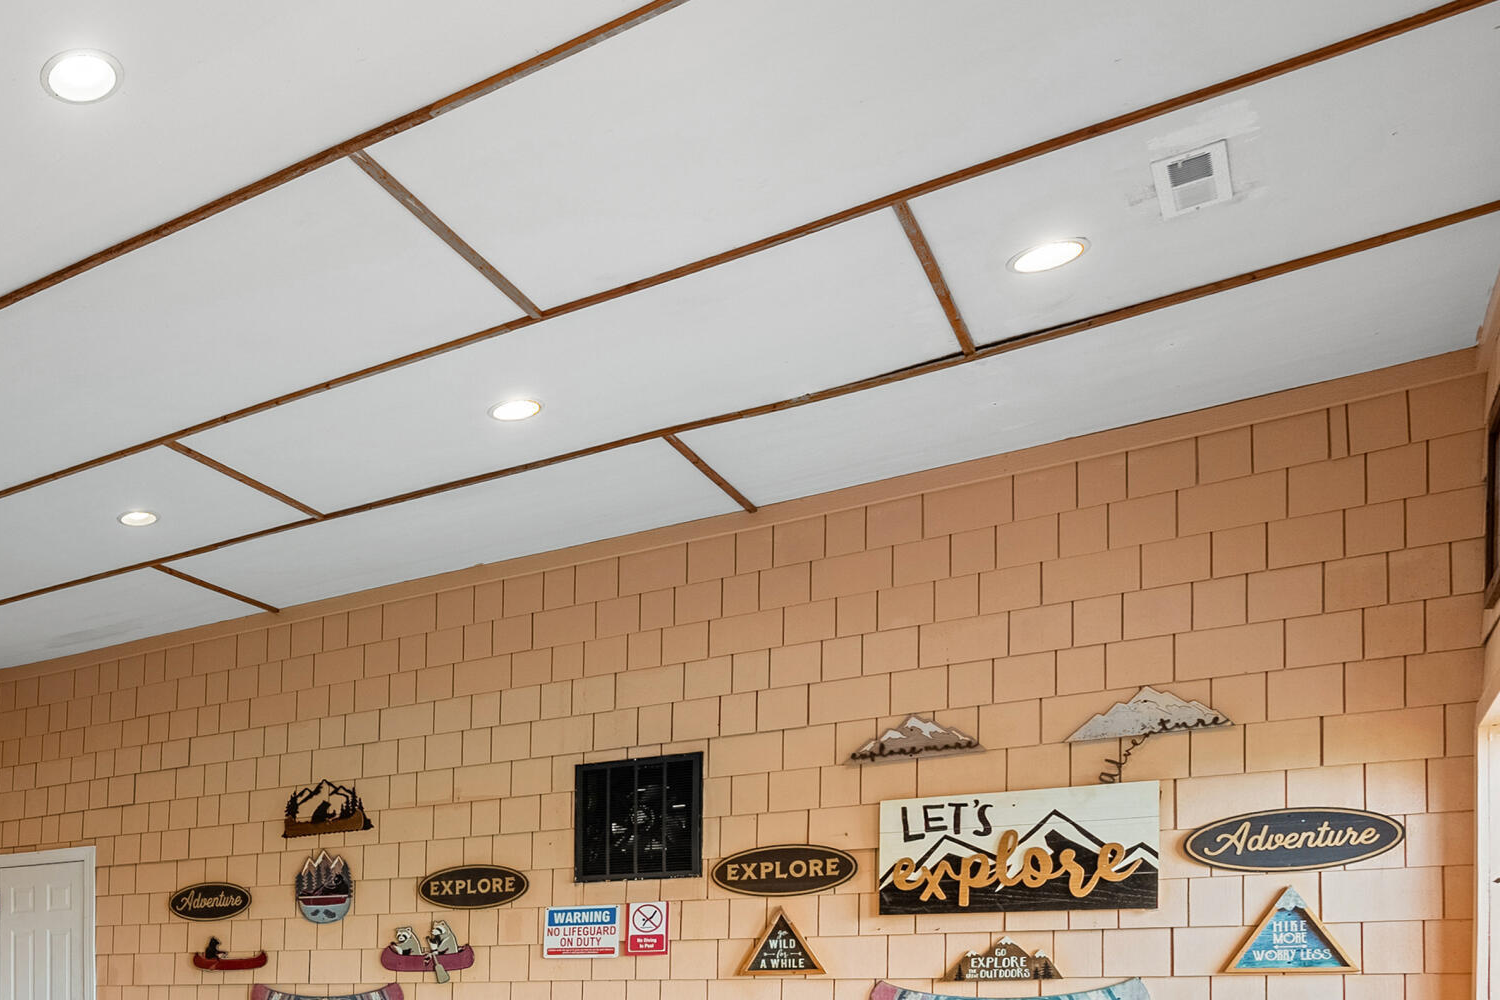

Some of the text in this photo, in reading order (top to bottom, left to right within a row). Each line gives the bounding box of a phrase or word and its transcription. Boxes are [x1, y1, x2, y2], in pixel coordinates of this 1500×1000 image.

[900, 799, 993, 843] LET'S
[1203, 820, 1381, 856] Adventure
[726, 856, 841, 882] EXPLORE
[893, 829, 1144, 907] explore
[429, 876, 516, 896] EXPLORE
[176, 889, 242, 911] Adventure
[553, 910, 610, 924] WARNING
[547, 926, 617, 937] NO LIFEGUARD
[1272, 920, 1307, 932] HIKE
[560, 937, 602, 947] ON DUTY
[768, 939, 796, 949] WILD
[1272, 932, 1307, 945] MORE
[995, 948, 1007, 956] GO
[1252, 948, 1333, 961] WORRY LESS
[760, 958, 805, 968] A WHILE
[970, 956, 1027, 968] EXPLORE
[980, 968, 1031, 979] OUTDOORS
